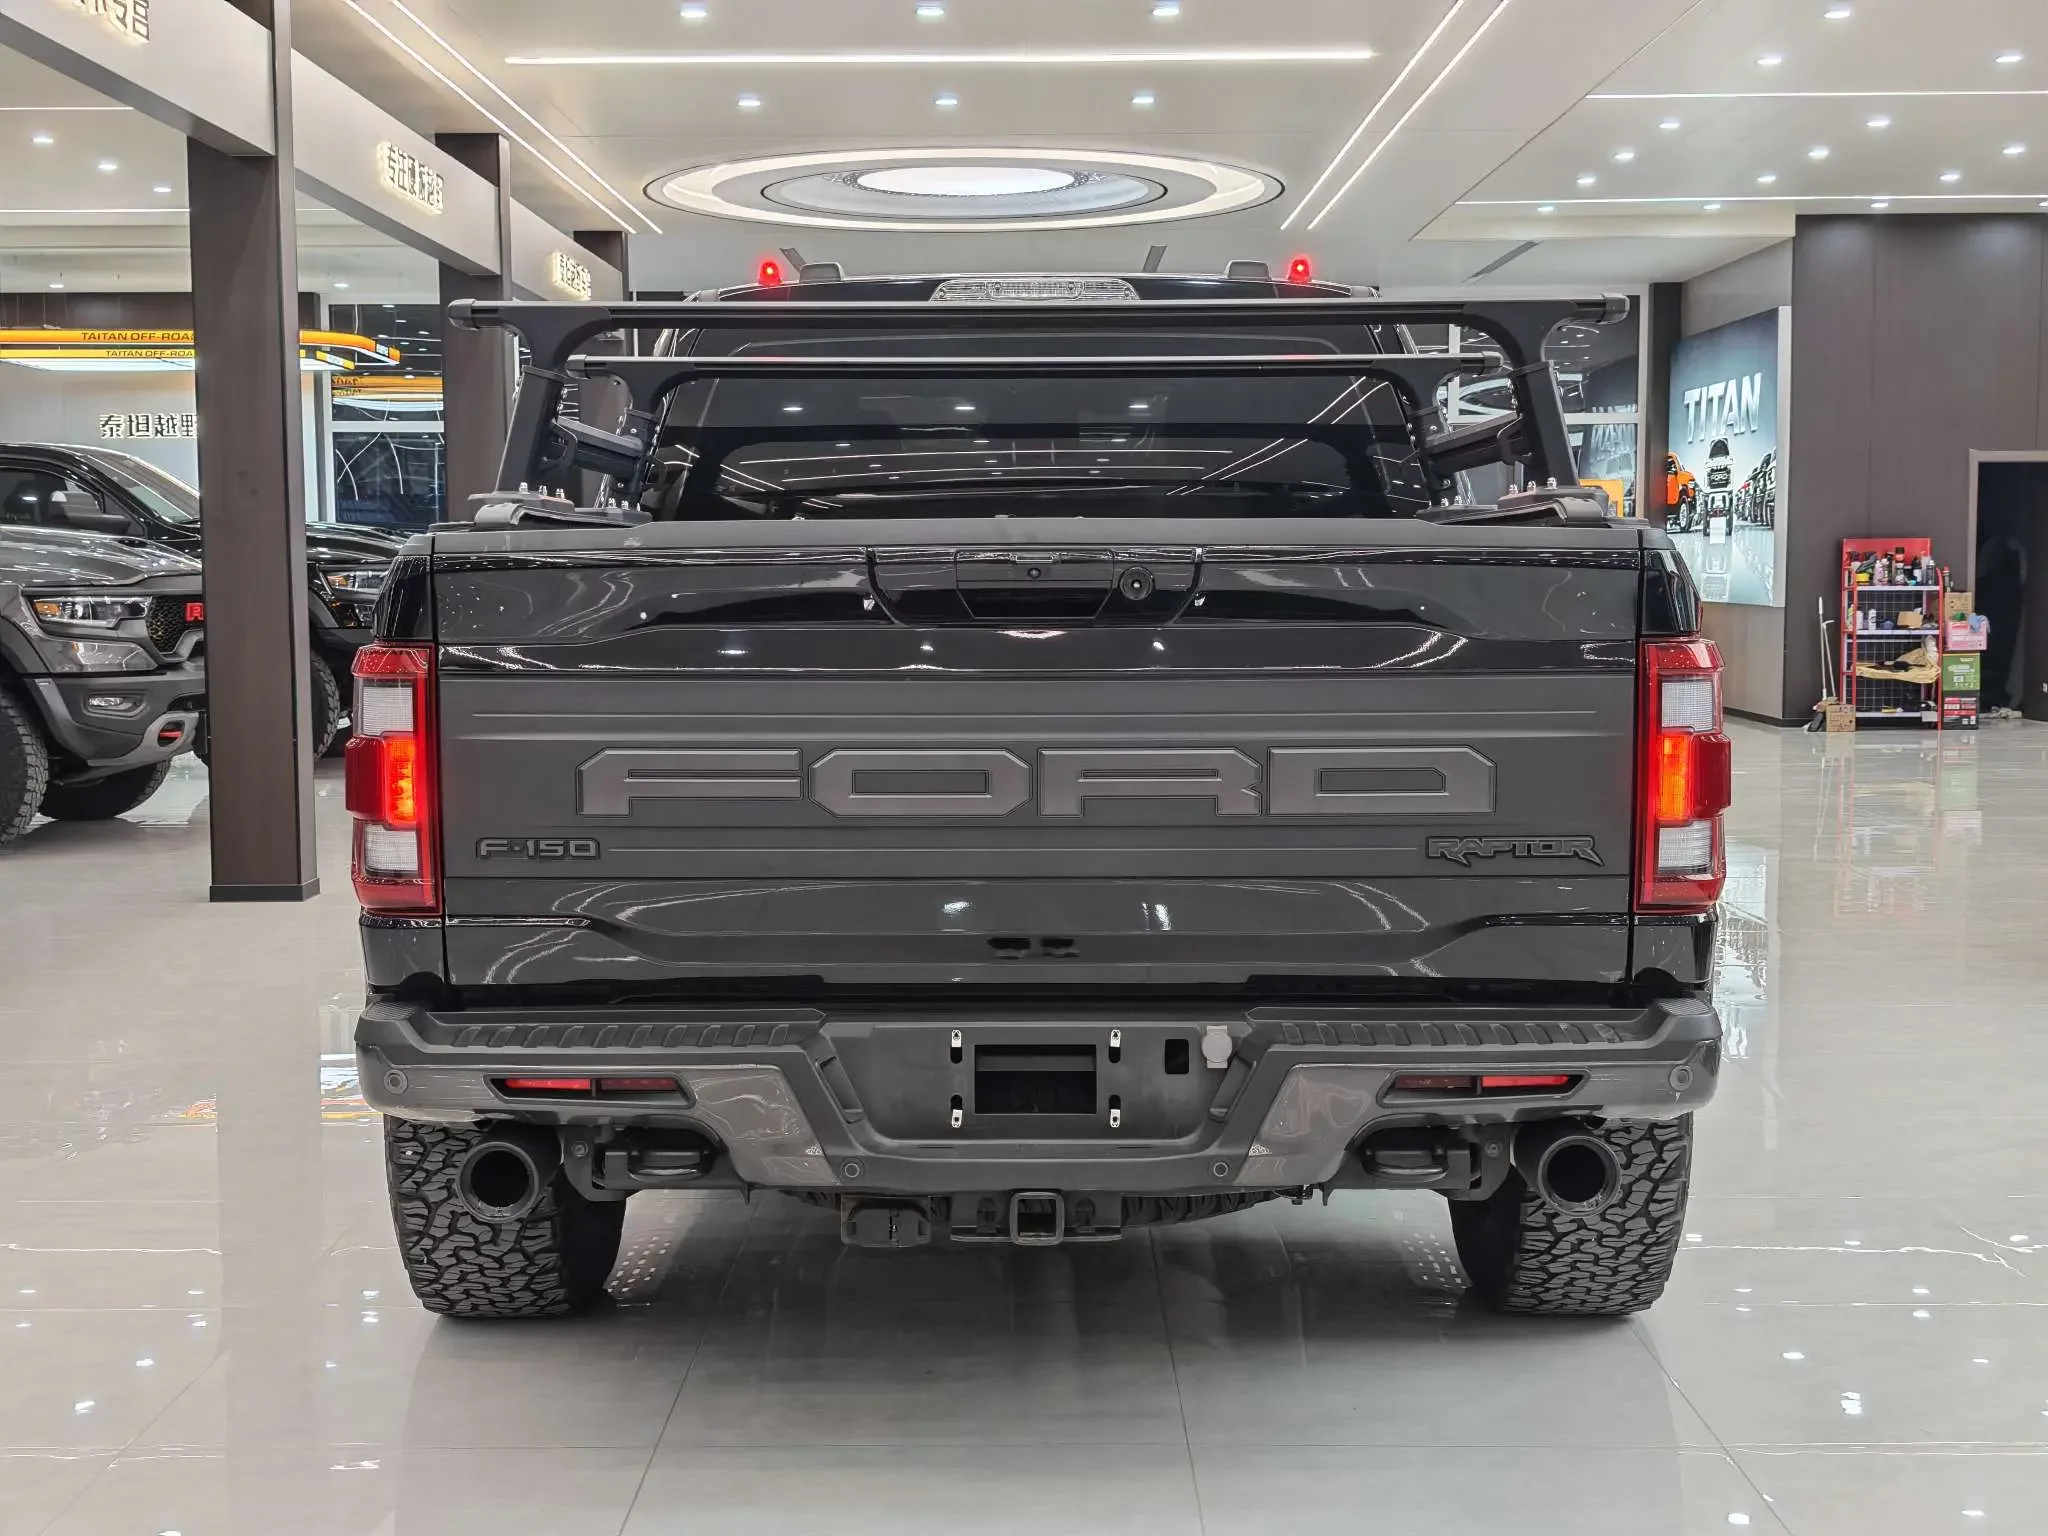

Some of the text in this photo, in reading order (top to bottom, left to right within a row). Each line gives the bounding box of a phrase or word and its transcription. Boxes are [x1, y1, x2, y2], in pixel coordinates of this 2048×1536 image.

[81, 332, 195, 341] TAITAN OFF-ROA
[1684, 372, 1762, 444] TITAN
[575, 746, 1497, 818] FORD
[476, 837, 600, 861] F-150
[1426, 835, 1604, 868] RAPTOR
